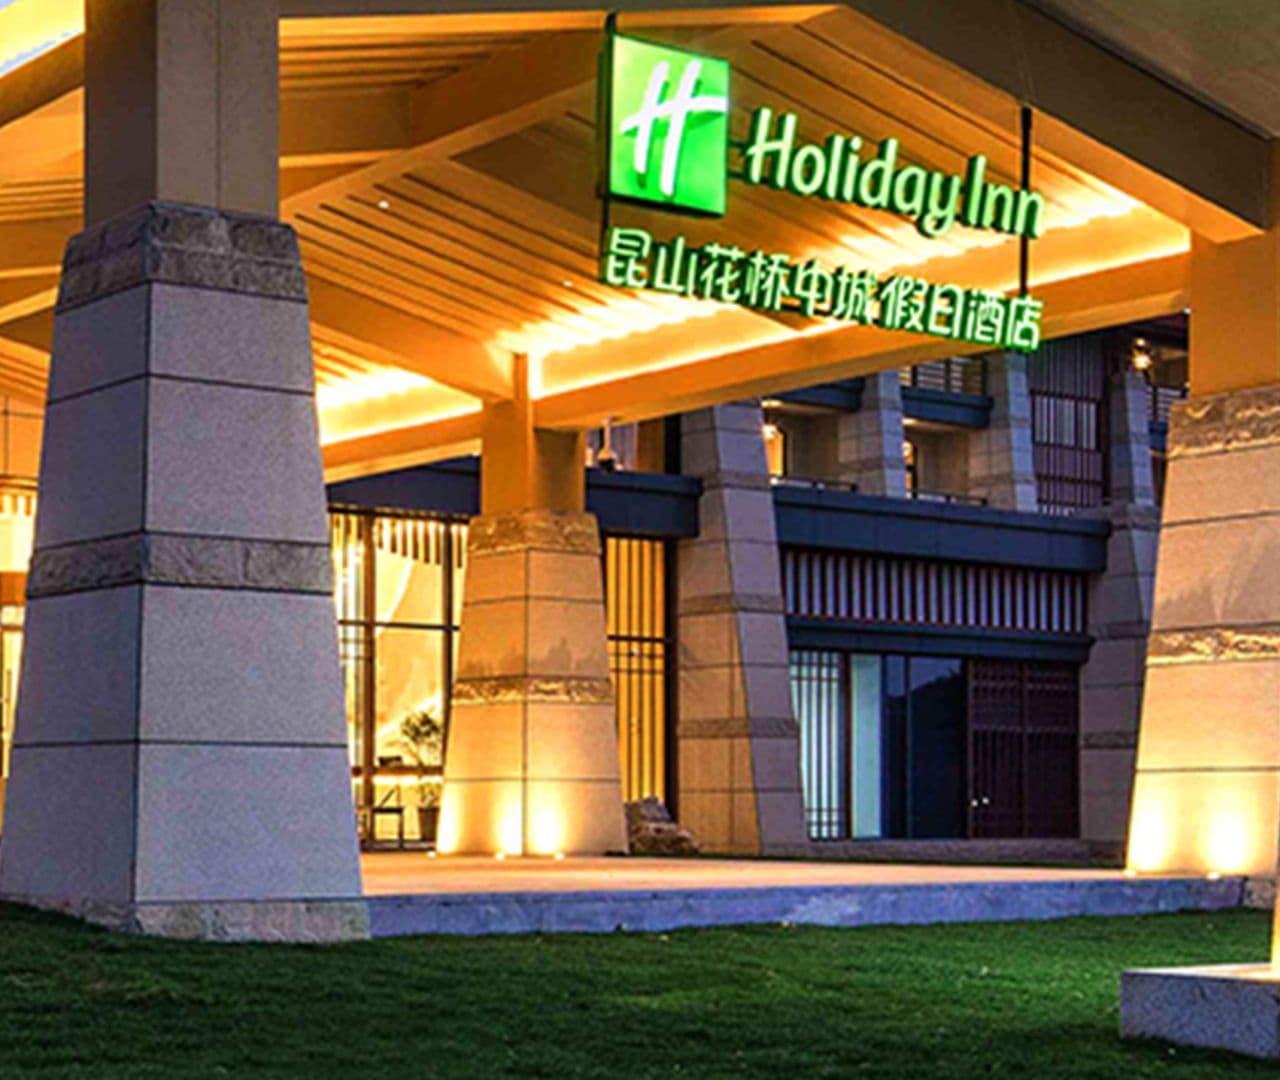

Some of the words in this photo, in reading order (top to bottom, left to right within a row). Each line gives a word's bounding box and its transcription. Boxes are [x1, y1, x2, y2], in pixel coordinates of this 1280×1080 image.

[746, 107, 961, 238] Holiday
[966, 154, 1046, 238] Inn
[605, 227, 1044, 350] 昆山花桥中城假日酒店
